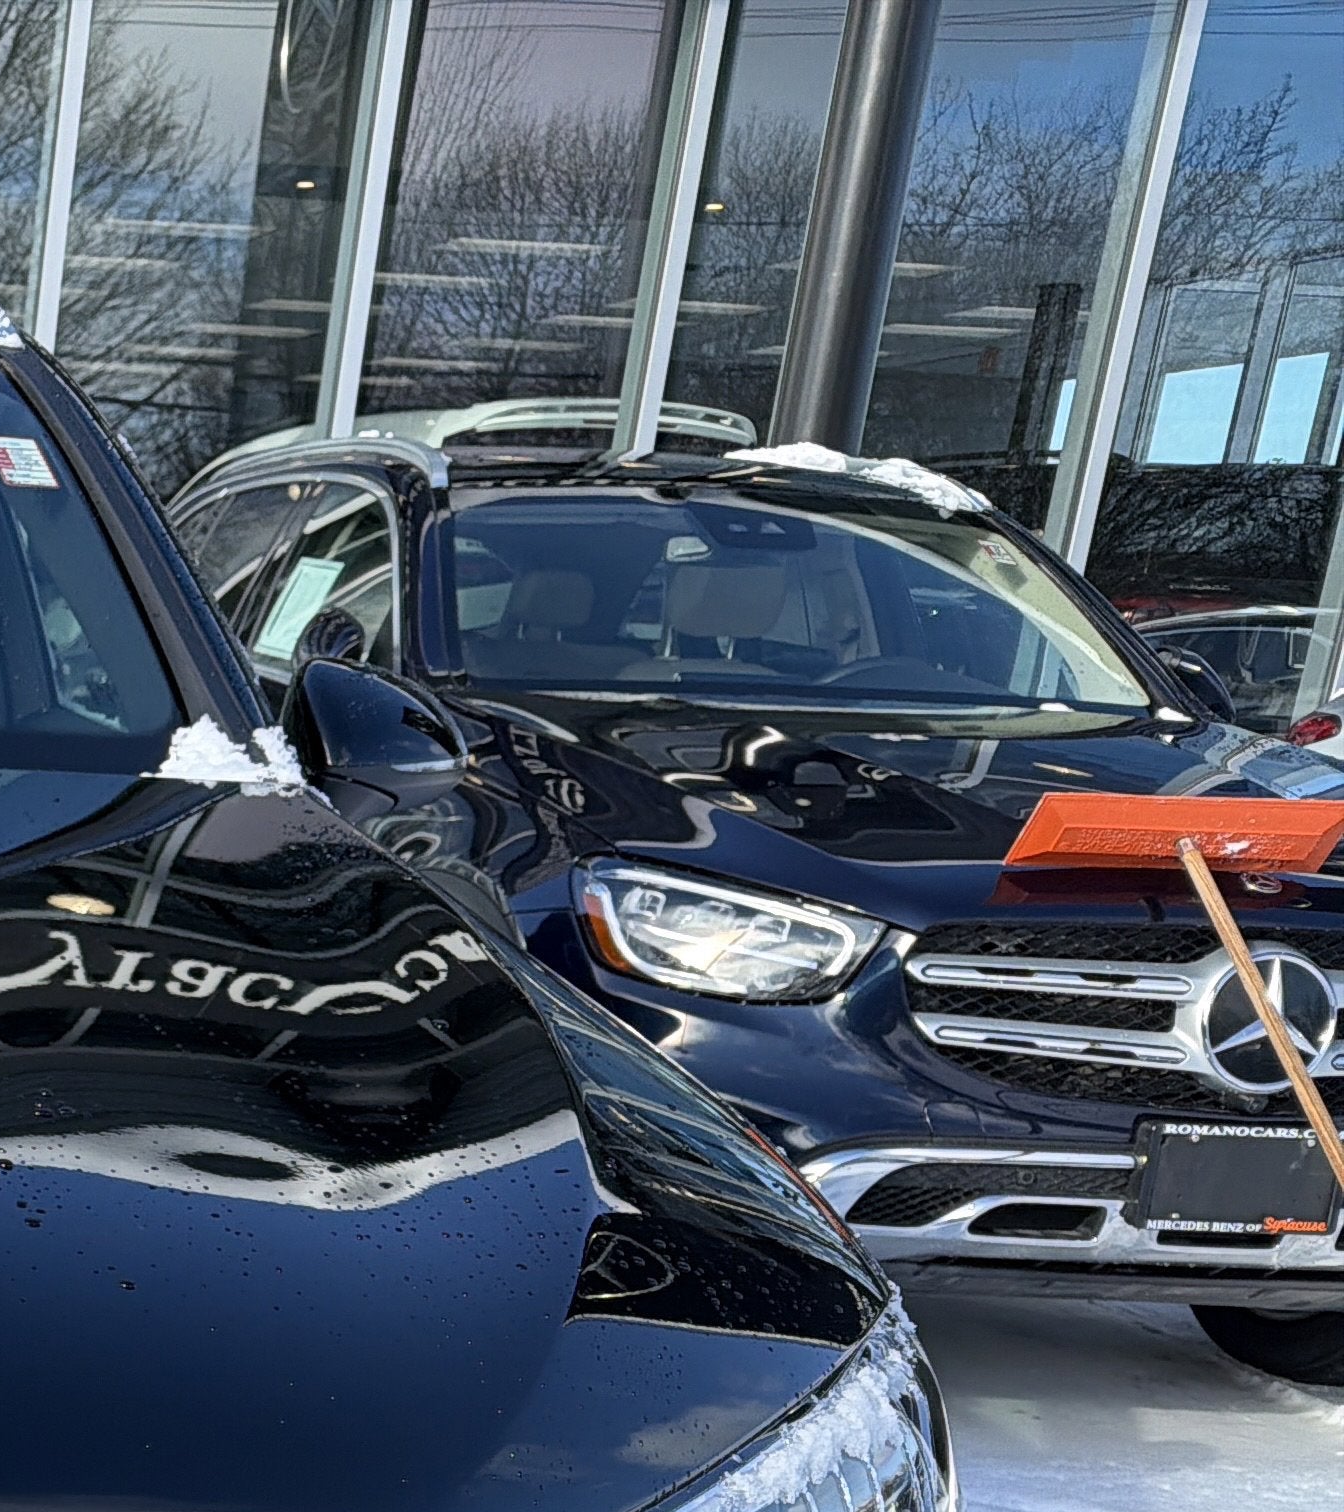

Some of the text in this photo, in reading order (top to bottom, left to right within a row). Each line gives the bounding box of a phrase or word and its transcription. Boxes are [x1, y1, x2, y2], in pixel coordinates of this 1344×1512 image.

[1163, 1123, 1344, 1141] ROMANOCARS.C
[1146, 1216, 1328, 1234] MERCEDES BENZ OF Syracuse
